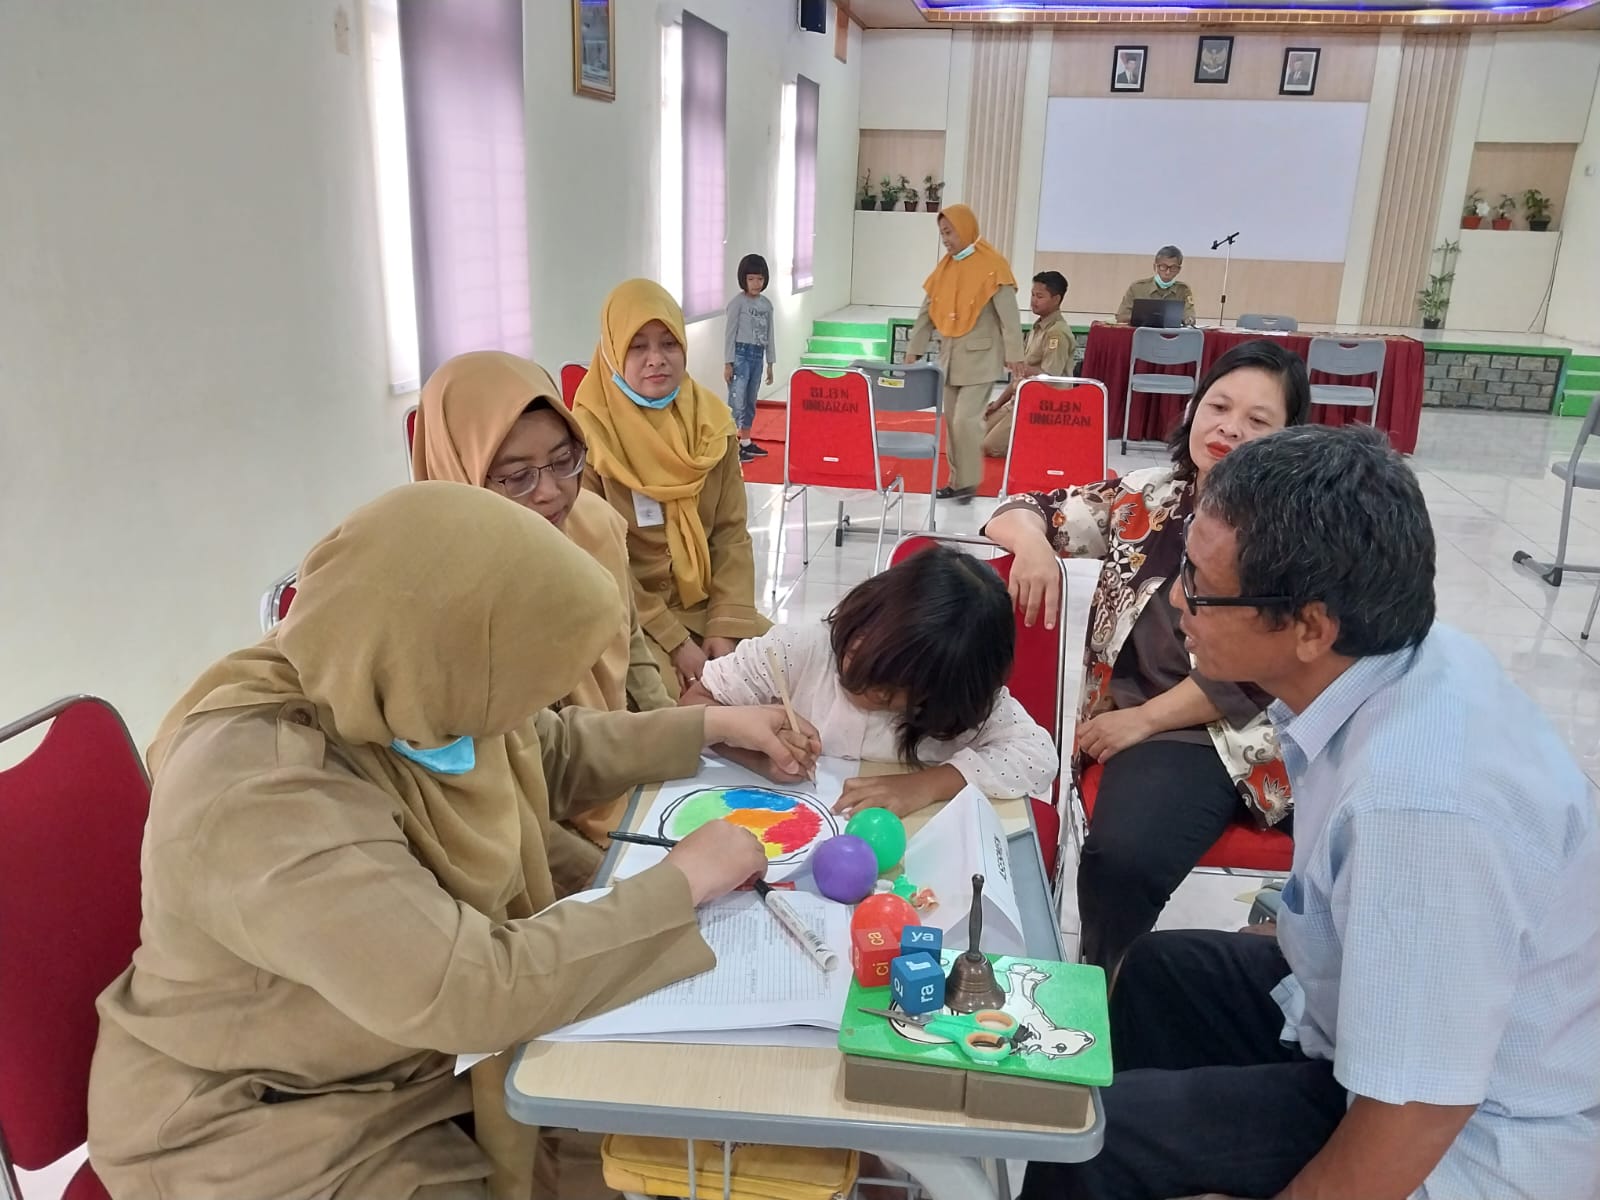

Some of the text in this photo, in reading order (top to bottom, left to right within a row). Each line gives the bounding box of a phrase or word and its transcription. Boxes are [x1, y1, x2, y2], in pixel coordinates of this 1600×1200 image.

[802, 399, 859, 413] UNGARAN
[1029, 412, 1091, 427] UNGARAN
[868, 931, 885, 946] ca
[911, 931, 934, 943] ya
[872, 961, 889, 976] ci
[905, 960, 932, 971] r
[920, 983, 934, 1003] ra
